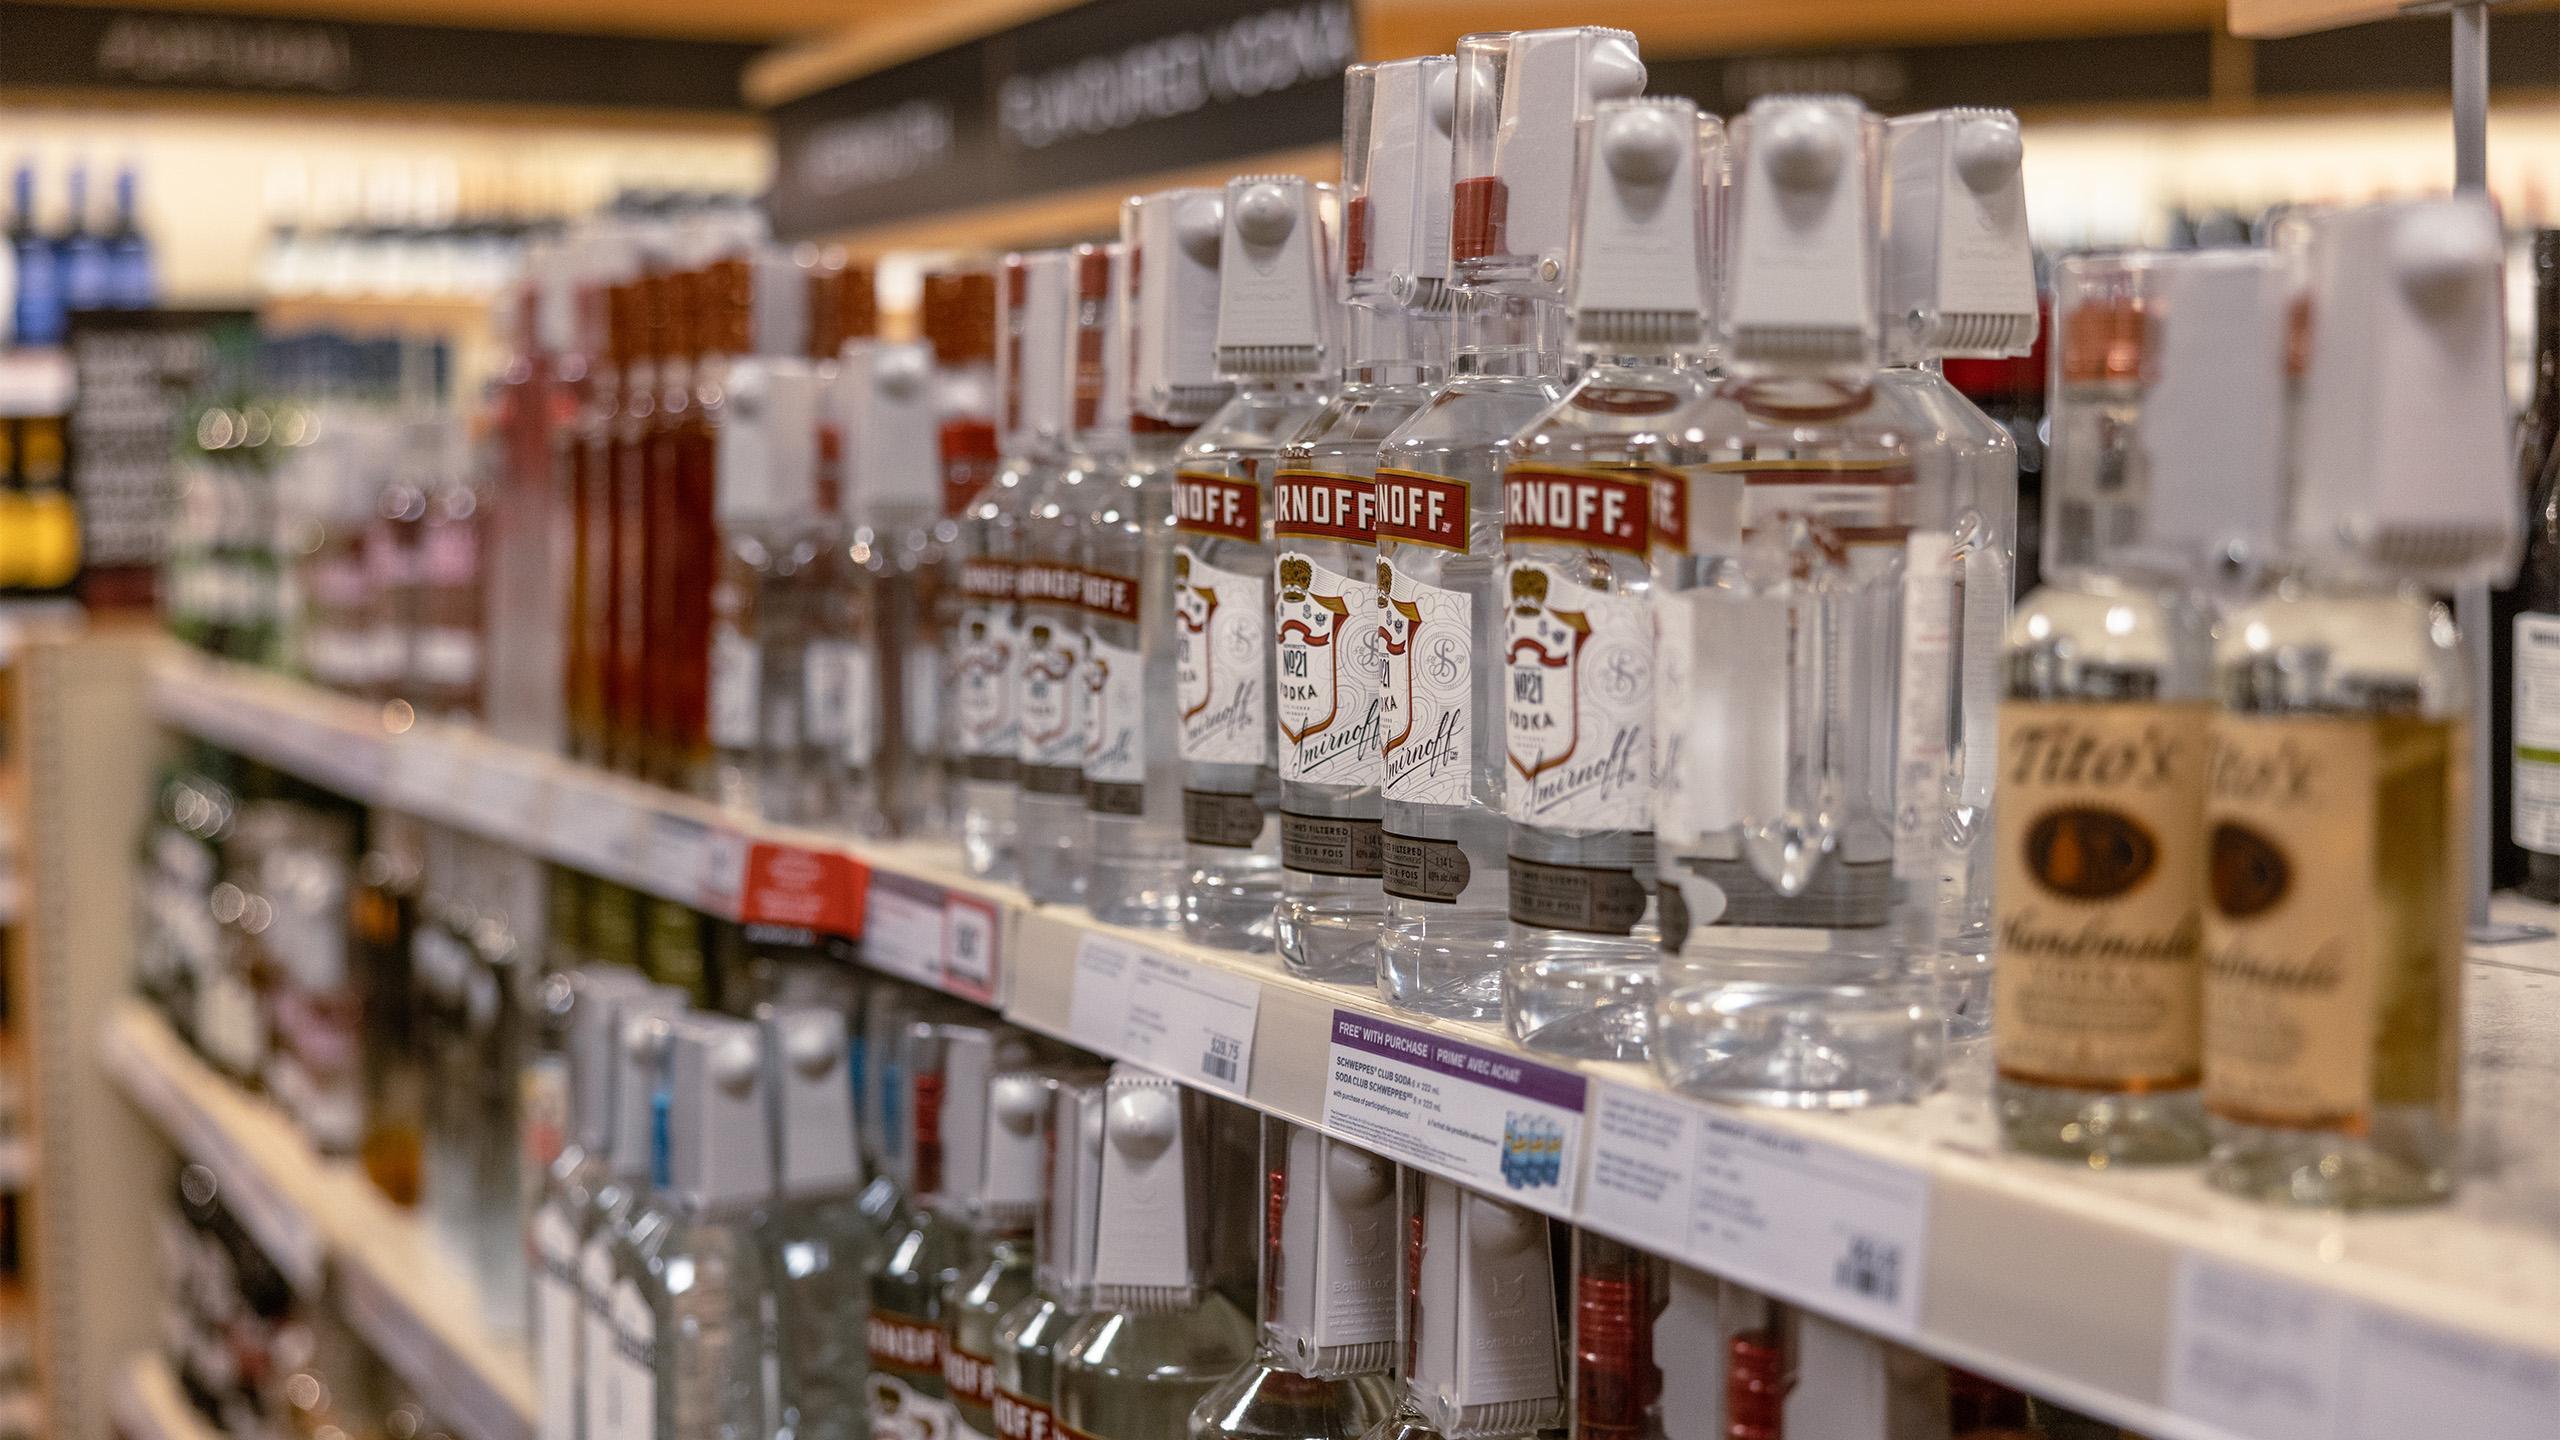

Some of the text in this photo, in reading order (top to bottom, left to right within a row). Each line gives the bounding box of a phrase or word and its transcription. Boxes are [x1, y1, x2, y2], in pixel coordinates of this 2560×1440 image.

[1362, 1027, 1383, 1045] WITH
[1384, 1034, 1429, 1058] PURCHASE
[1466, 1057, 1491, 1076] AVEC
[1335, 1071, 1352, 1085] SODA
[1352, 1076, 1369, 1089] CLUB
[1378, 1068, 1394, 1081] CLUB
[1394, 1073, 1411, 1086] SODA
